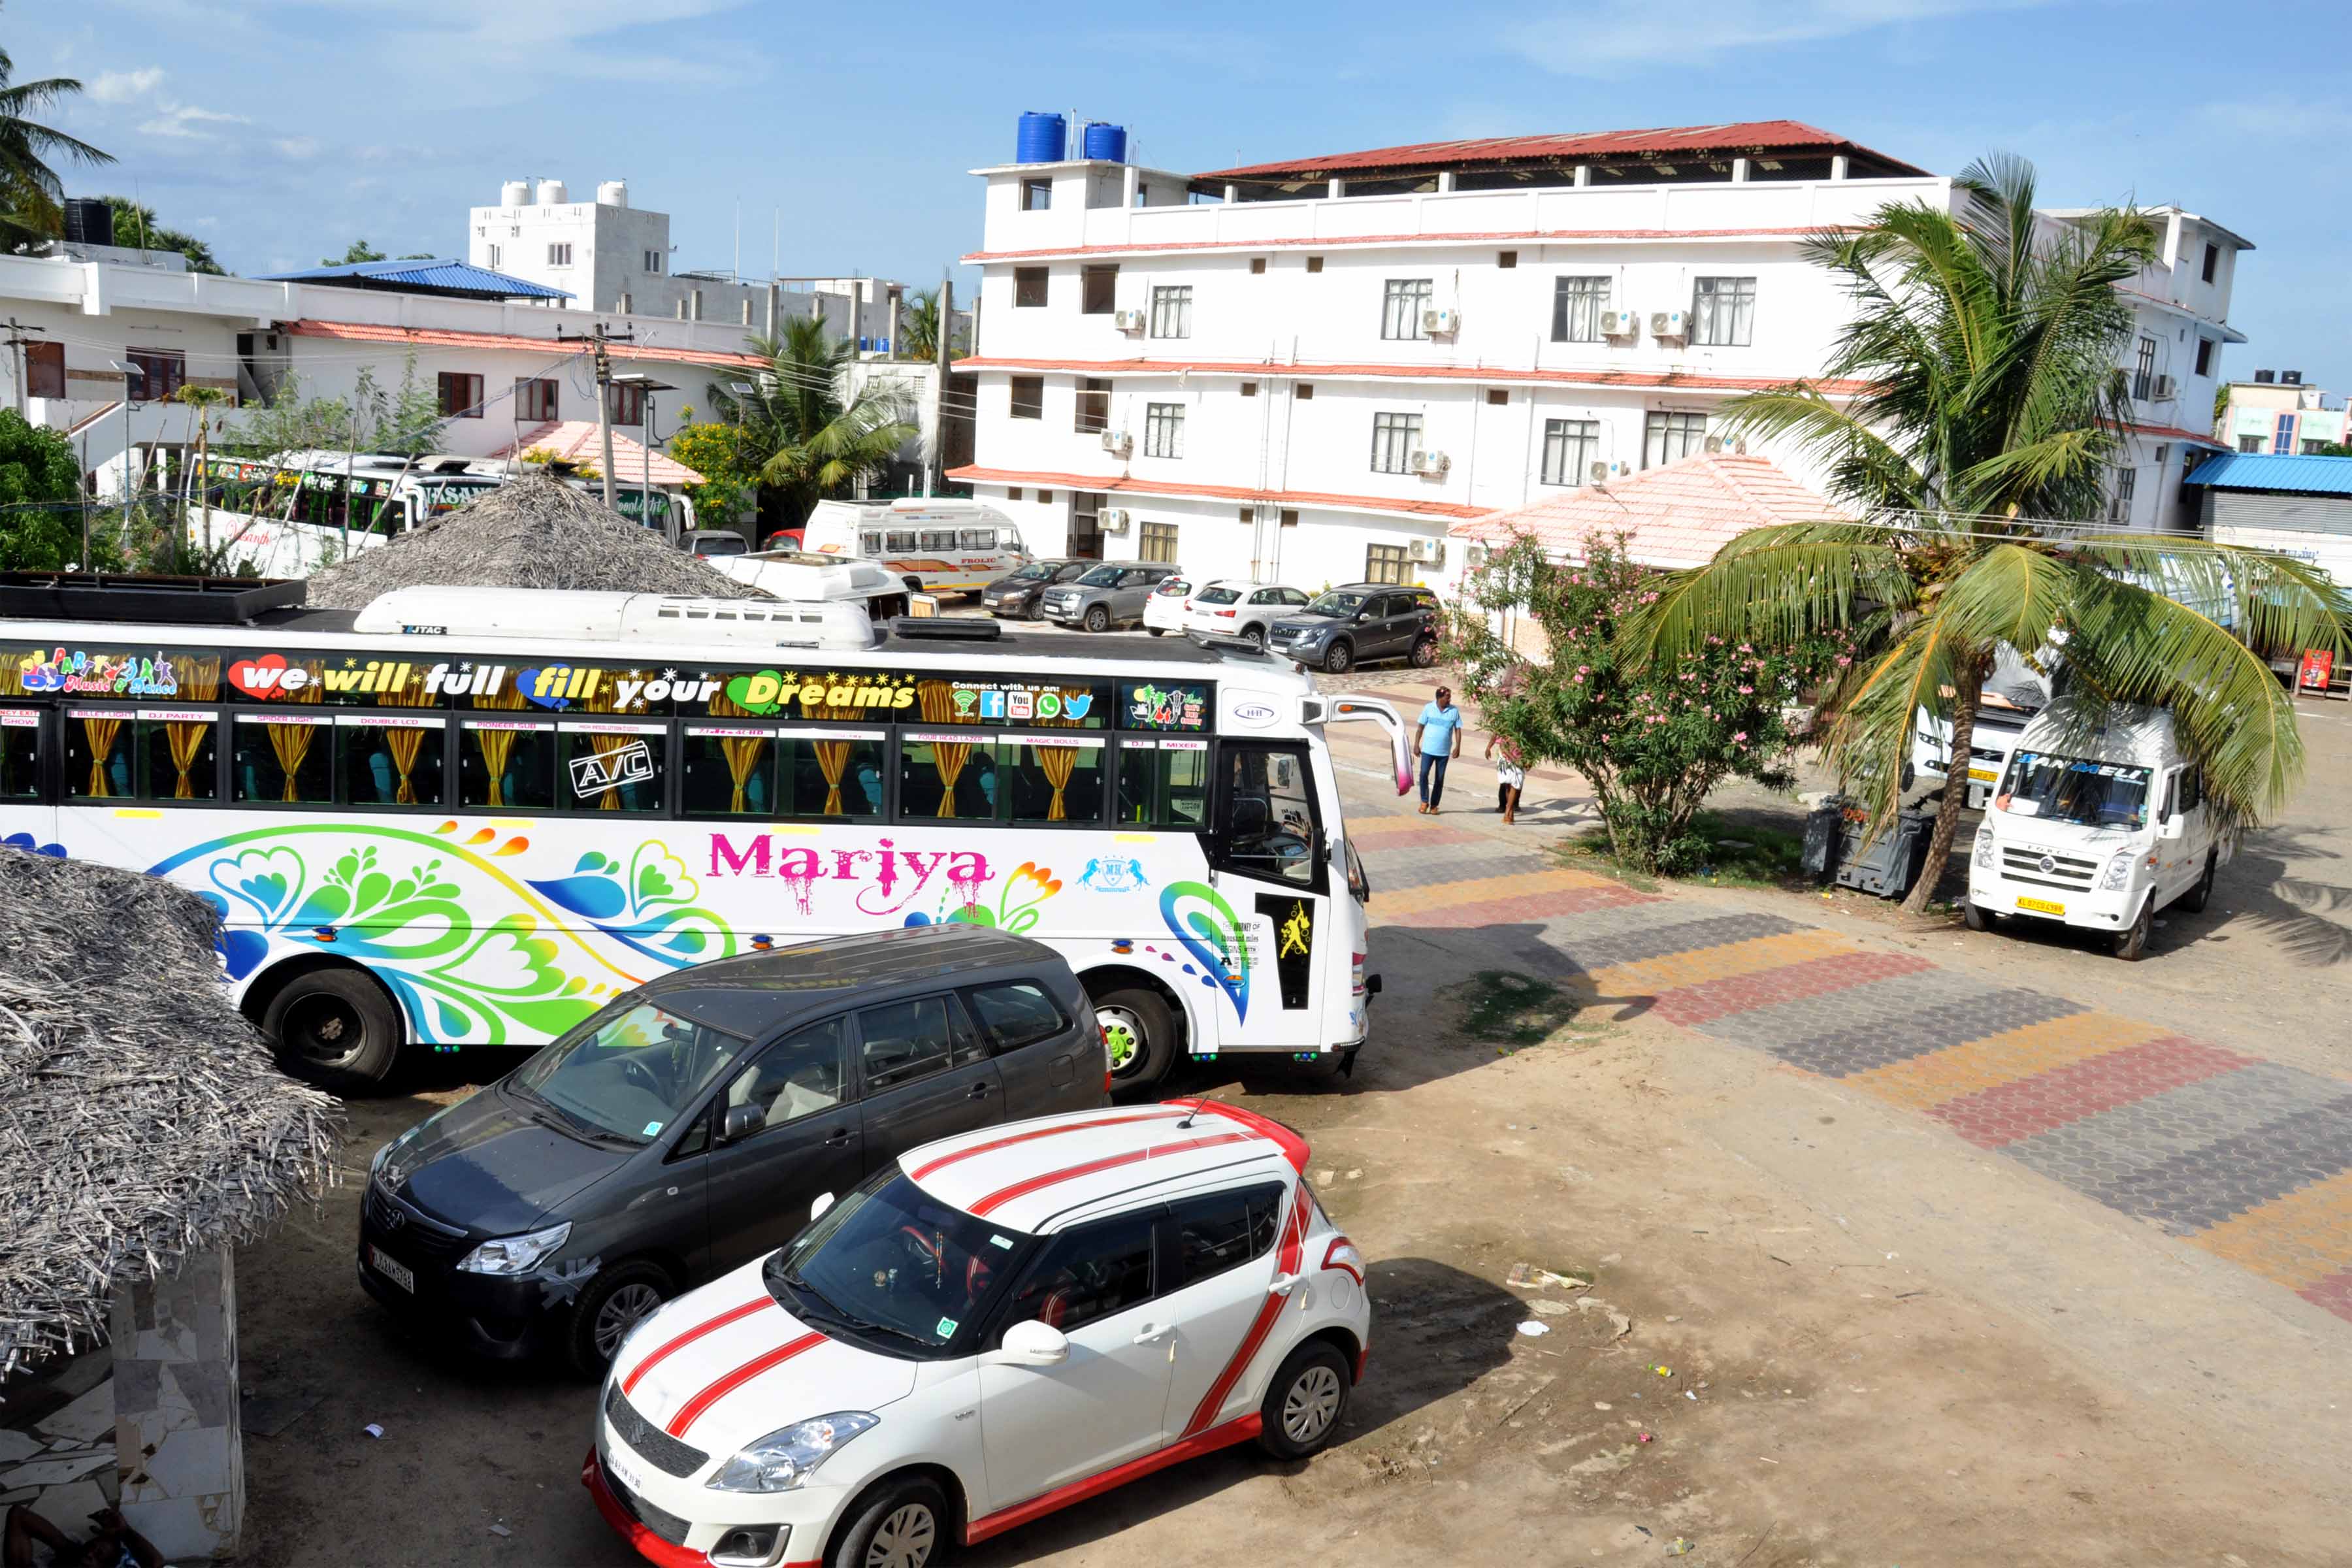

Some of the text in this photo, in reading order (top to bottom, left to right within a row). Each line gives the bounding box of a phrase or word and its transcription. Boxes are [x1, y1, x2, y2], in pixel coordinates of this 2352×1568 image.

[54, 647, 109, 677] PARTY
[63, 675, 110, 693] Music
[129, 676, 178, 695] Dance
[242, 661, 915, 708] we will full fill your Dreams
[951, 681, 998, 691] Connect
[1000, 683, 1024, 691] with
[1013, 694, 1028, 705] You
[705, 833, 997, 919] Mariya
